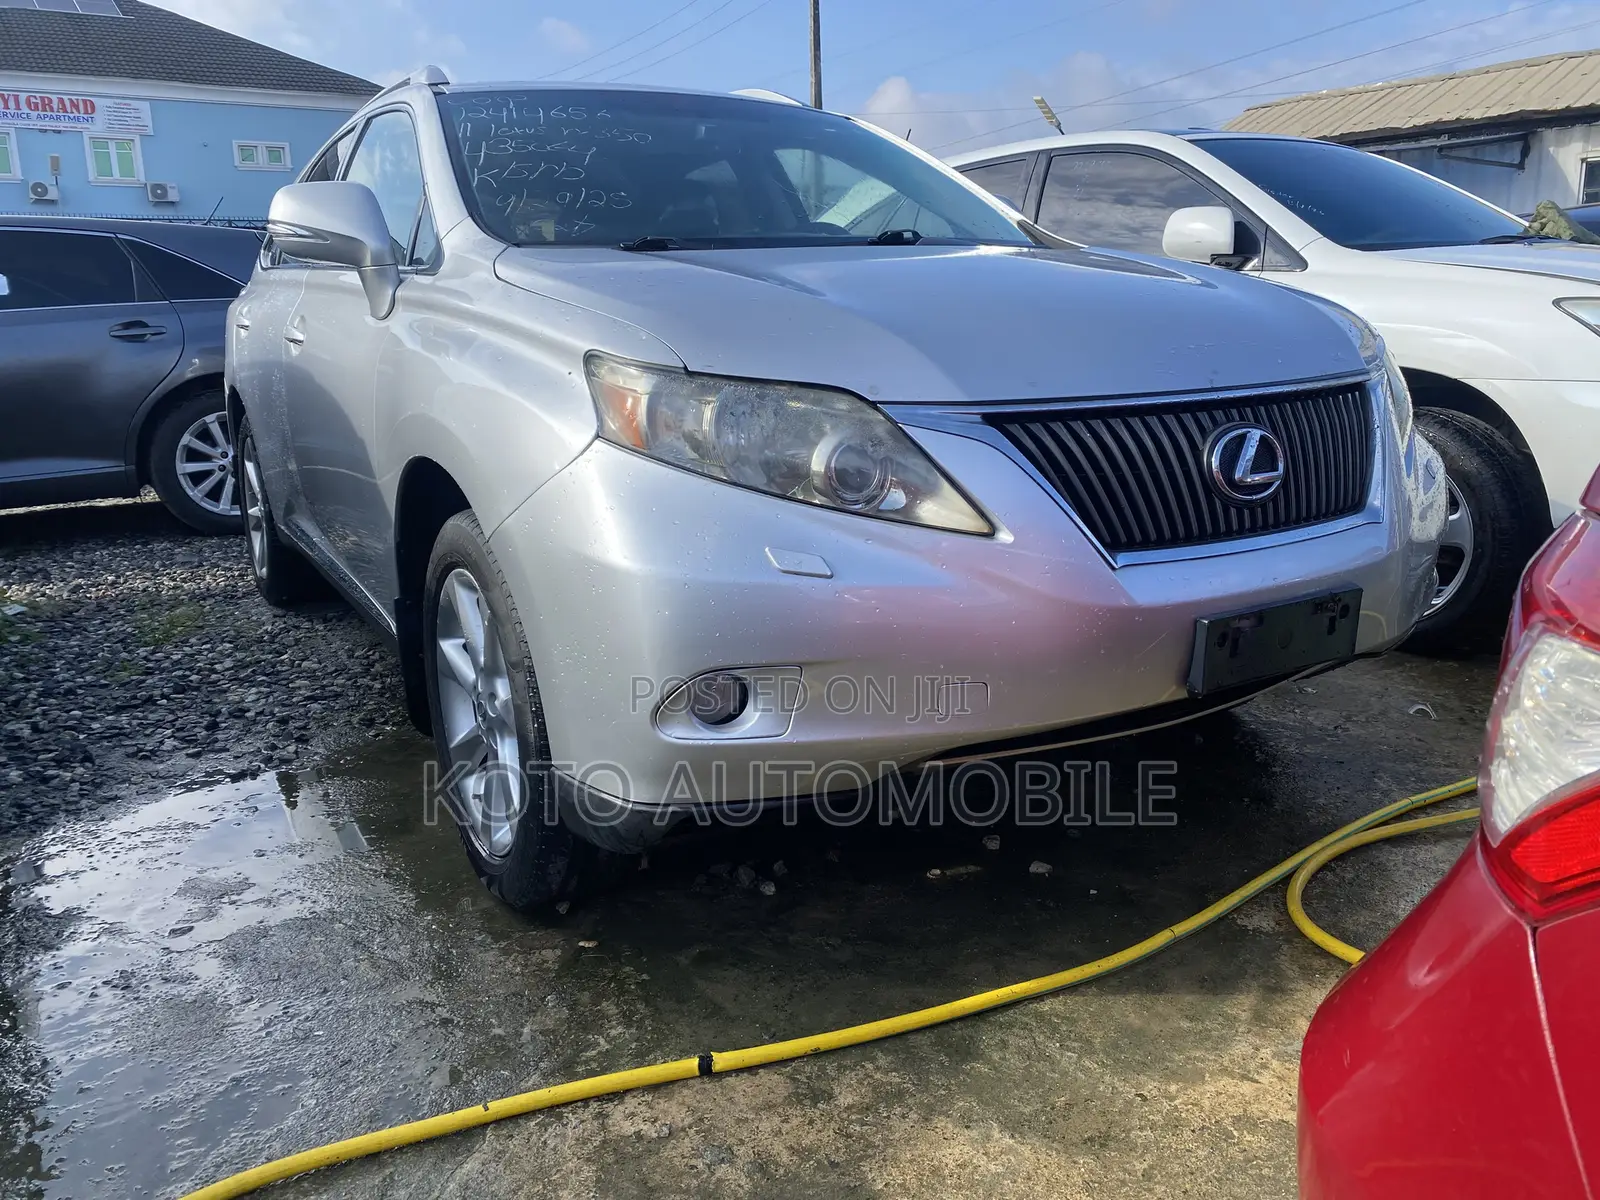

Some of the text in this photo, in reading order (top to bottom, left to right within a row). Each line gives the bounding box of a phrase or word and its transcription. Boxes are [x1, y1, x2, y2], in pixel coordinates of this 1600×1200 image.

[25, 94, 96, 115] GRAND
[0, 111, 95, 123] RVICE APARTMENT
